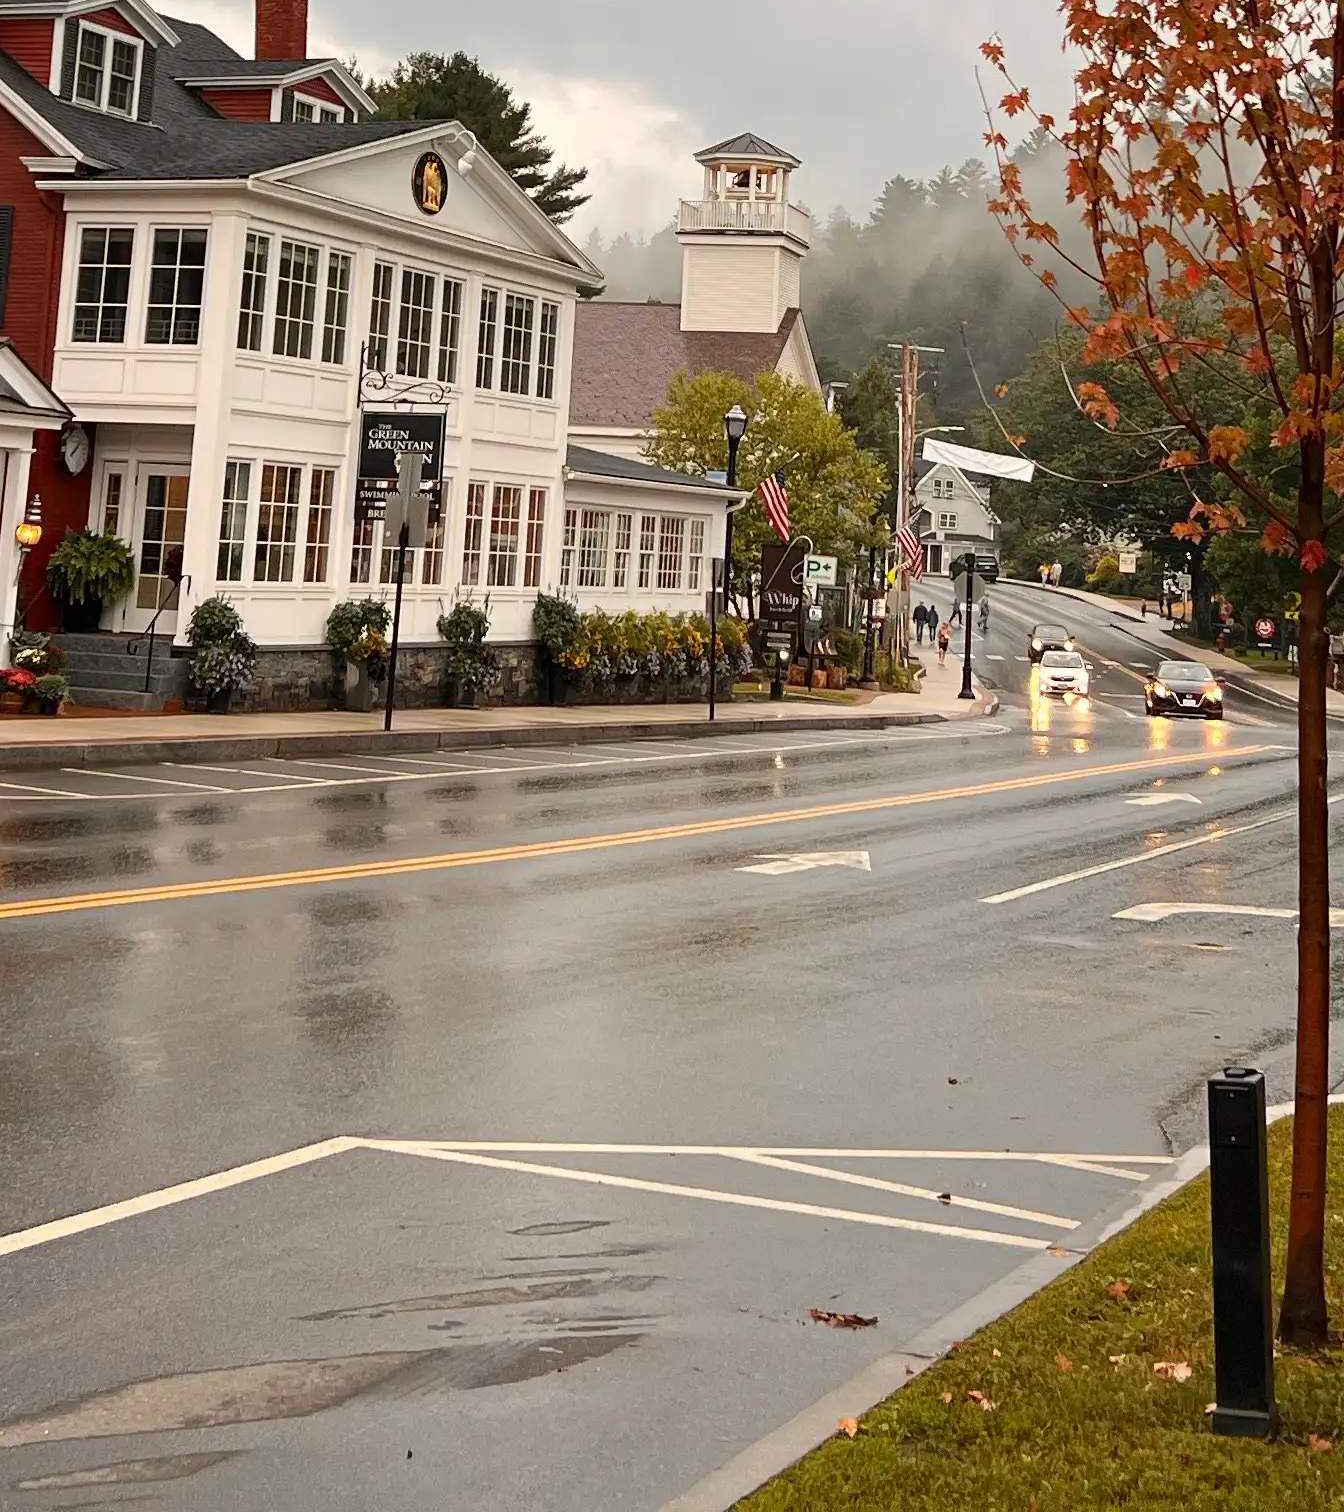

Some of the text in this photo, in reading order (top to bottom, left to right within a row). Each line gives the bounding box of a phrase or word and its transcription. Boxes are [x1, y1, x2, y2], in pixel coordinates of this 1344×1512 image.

[368, 428, 410, 440] GREEN
[367, 438, 435, 451] MOUNTAIN
[767, 591, 800, 609] Whip
